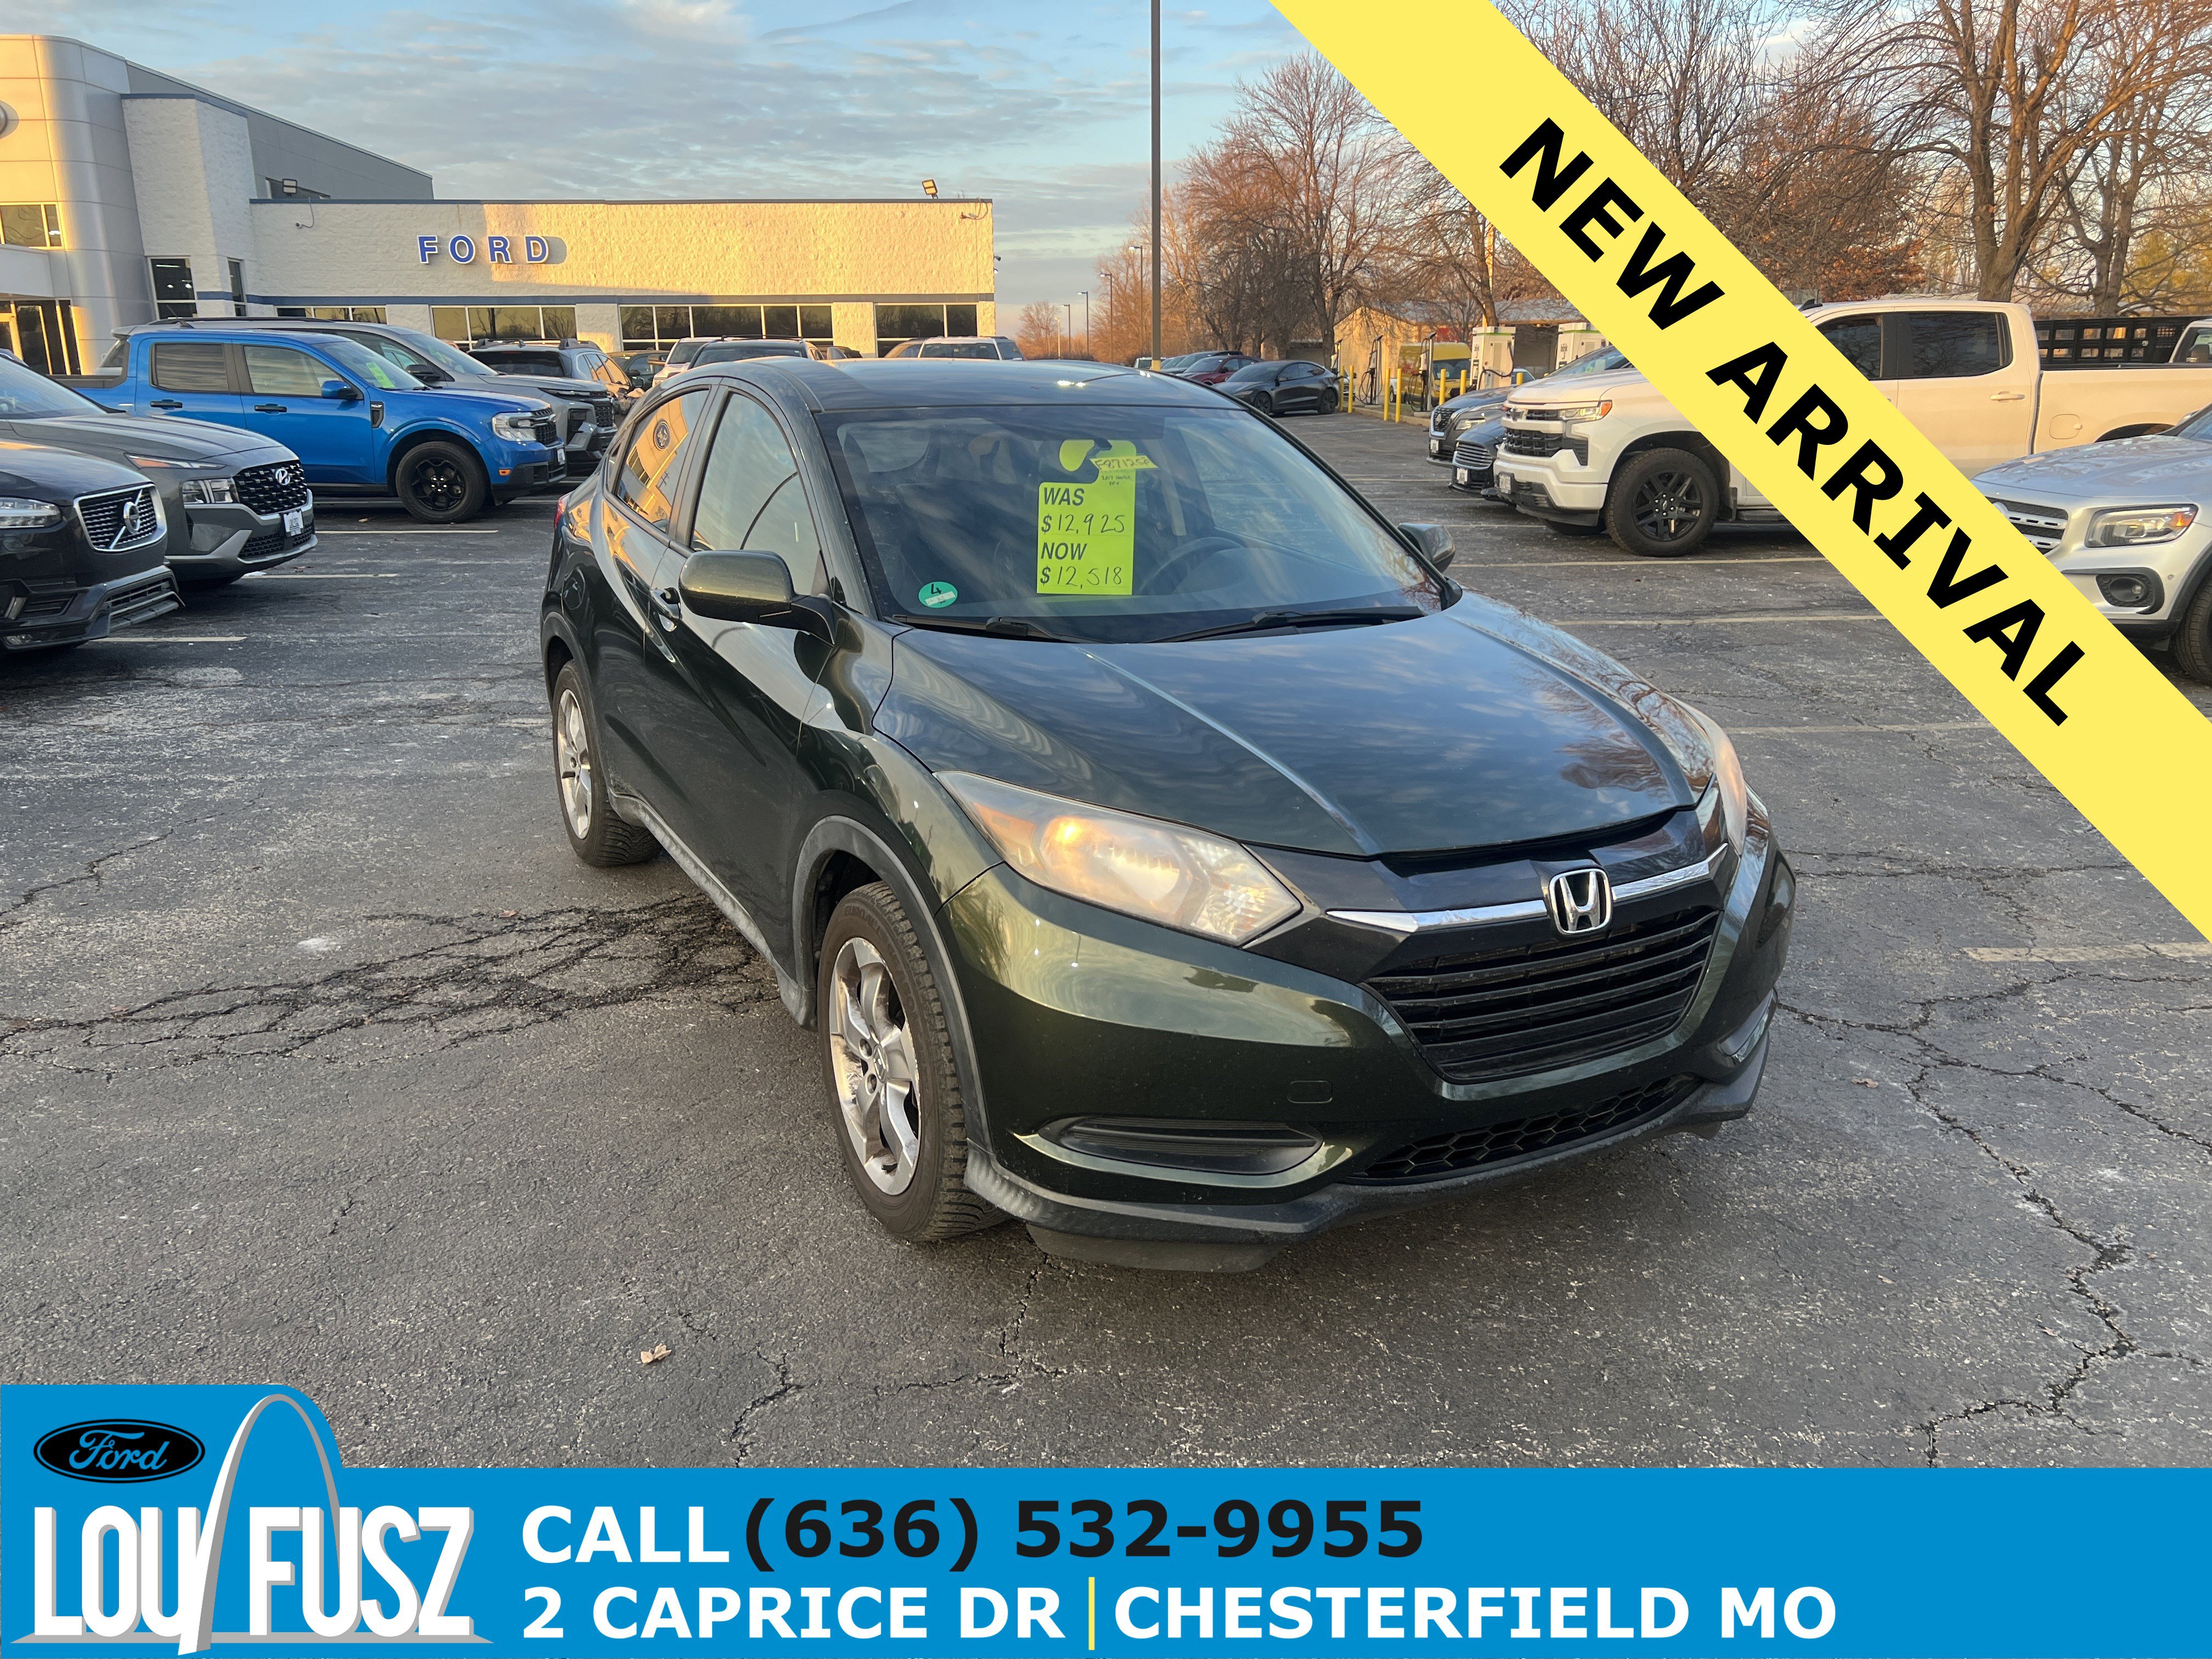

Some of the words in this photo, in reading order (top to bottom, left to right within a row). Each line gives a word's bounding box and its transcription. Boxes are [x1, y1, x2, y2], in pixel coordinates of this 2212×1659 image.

[417, 234, 549, 264] FORD
[1043, 487, 1085, 506] WAS
[1041, 514, 1125, 535] $12,925
[1041, 542, 1087, 560] NOW
[1040, 566, 1122, 589] $12,518
